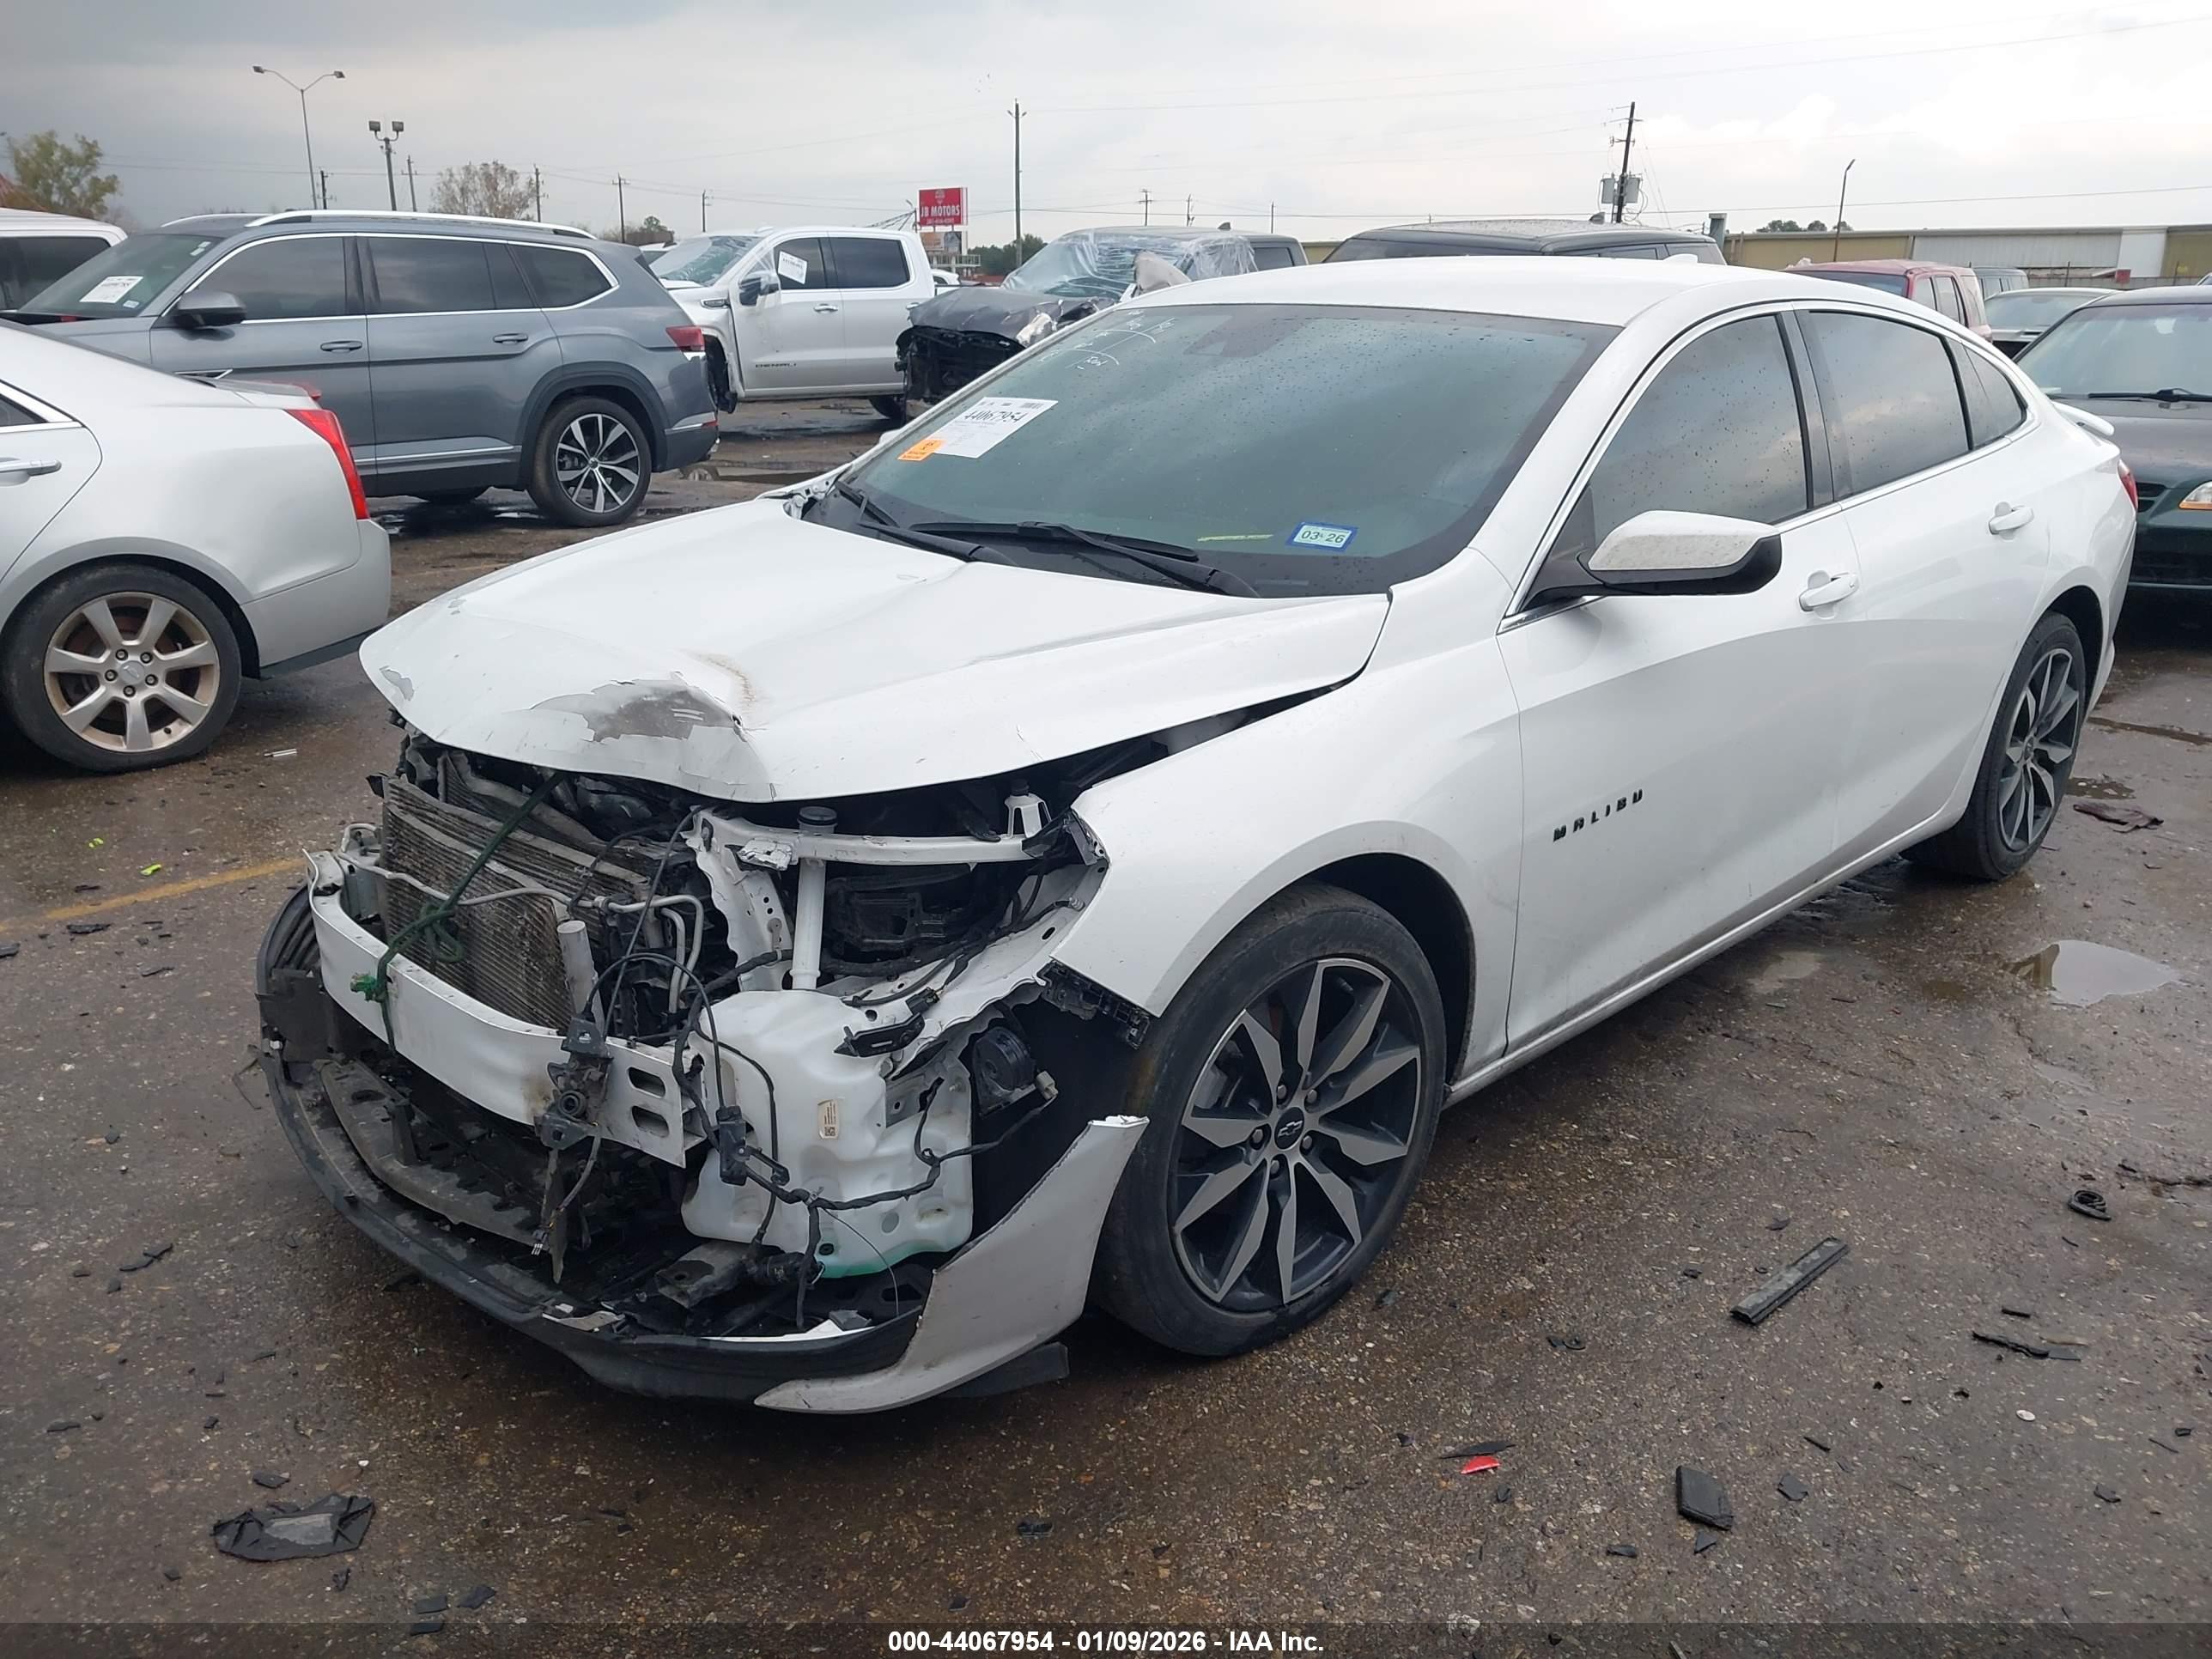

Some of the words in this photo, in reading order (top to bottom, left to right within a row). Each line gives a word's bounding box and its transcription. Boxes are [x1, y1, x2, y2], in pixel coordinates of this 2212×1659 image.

[931, 204, 960, 216] MOTORS
[1301, 530, 1320, 540] 03
[1325, 532, 1346, 544] 26
[1553, 788, 1643, 842] MALIBU
